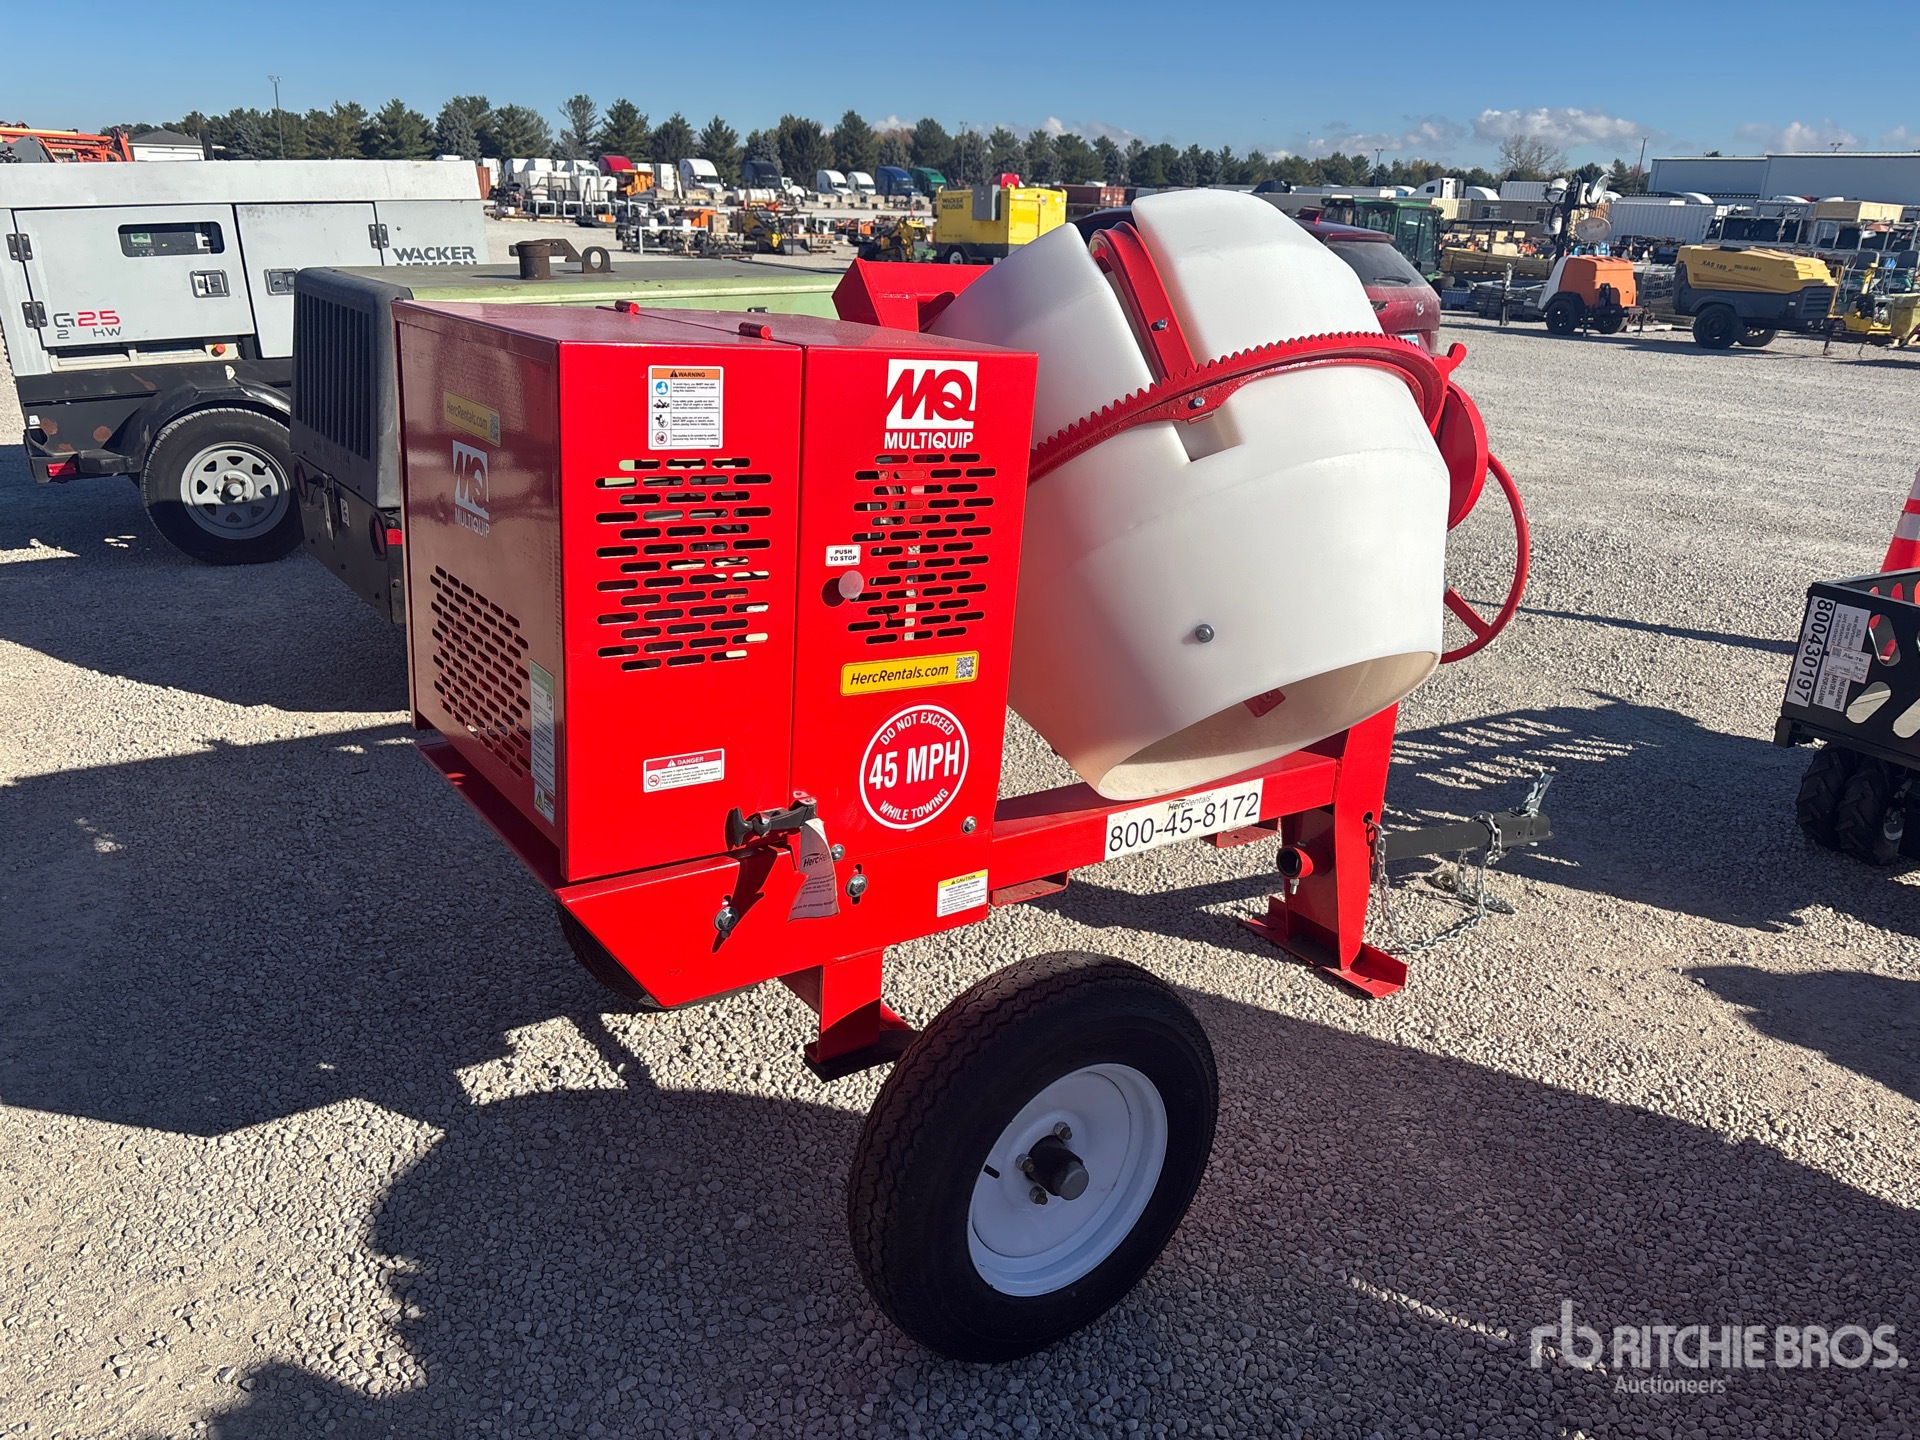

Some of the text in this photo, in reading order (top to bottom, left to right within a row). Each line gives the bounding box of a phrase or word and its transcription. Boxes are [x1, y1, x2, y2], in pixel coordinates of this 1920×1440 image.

[392, 246, 477, 261] WACKER
[57, 329, 70, 340] 2
[446, 402, 488, 430] HercRentals.com
[884, 432, 974, 449] MULTIQUIP
[454, 507, 490, 538] MULTIQUIP
[1794, 600, 1833, 702] 800430197
[850, 665, 949, 685] HercRentals.com
[880, 712, 955, 745] DO NOT EXCEED
[677, 756, 704, 766] DANGER
[868, 739, 960, 790] 45 MPH
[879, 787, 950, 820] WHILE TOWING
[1167, 794, 1213, 811] HercRentals
[1109, 792, 1259, 852] 800-45-8172
[956, 875, 976, 884] CAUTION
